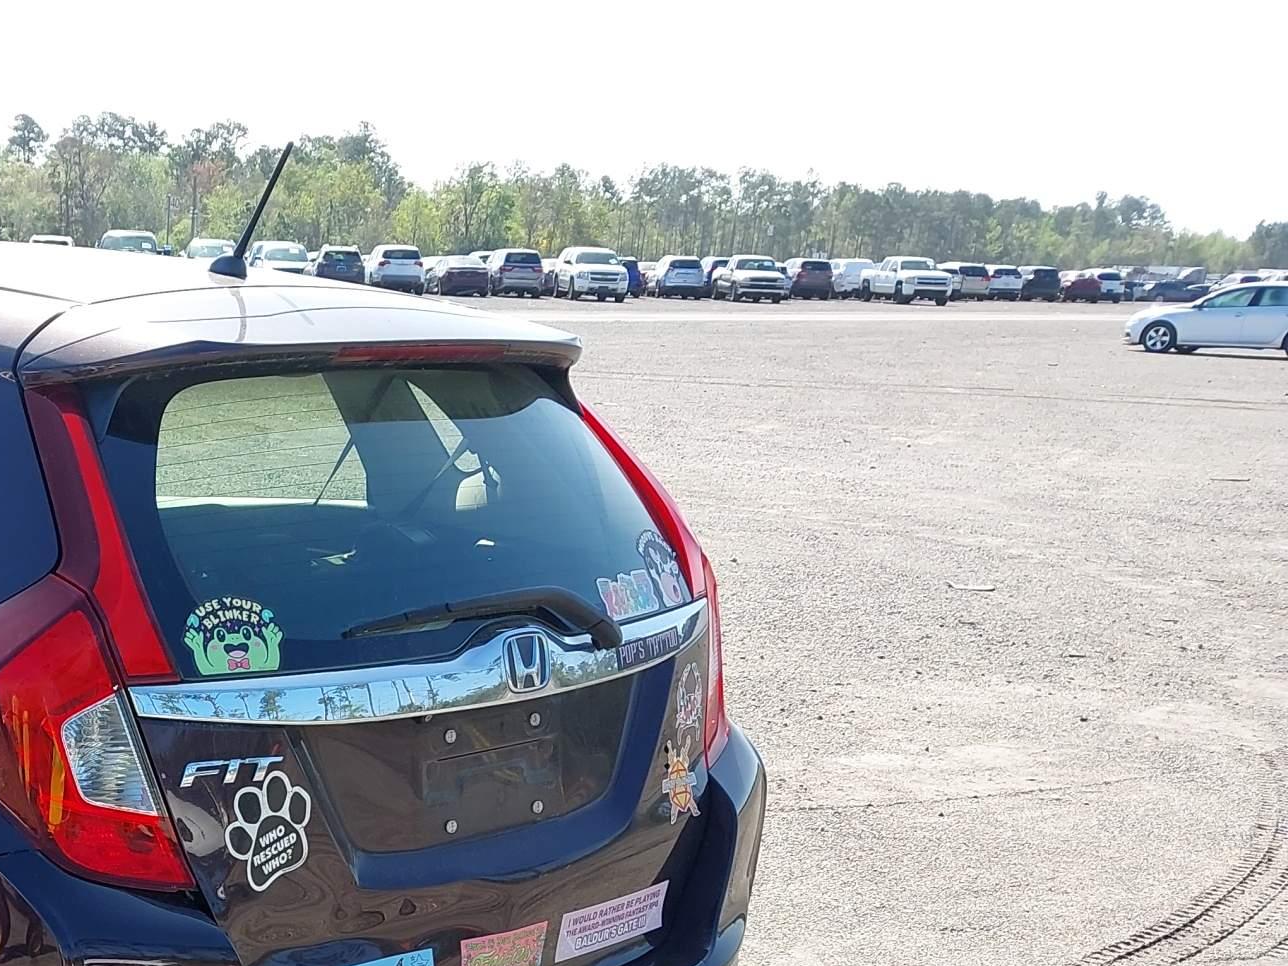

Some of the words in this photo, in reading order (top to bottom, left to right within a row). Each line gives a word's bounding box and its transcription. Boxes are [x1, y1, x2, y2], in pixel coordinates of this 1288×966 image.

[196, 599, 221, 617] USE
[222, 597, 262, 613] YOUR
[202, 609, 260, 629] BLINKER
[618, 640, 645, 667] POP'S
[180, 755, 284, 788] FIT
[253, 832, 297, 867] RESCUED
[259, 825, 285, 847] WHO
[261, 848, 294, 875] WHO?
[572, 911, 598, 926] WOULD
[599, 902, 625, 918] RATHER
[626, 898, 635, 909] BE
[634, 889, 661, 906] PLAYING
[617, 917, 638, 936] GATE
